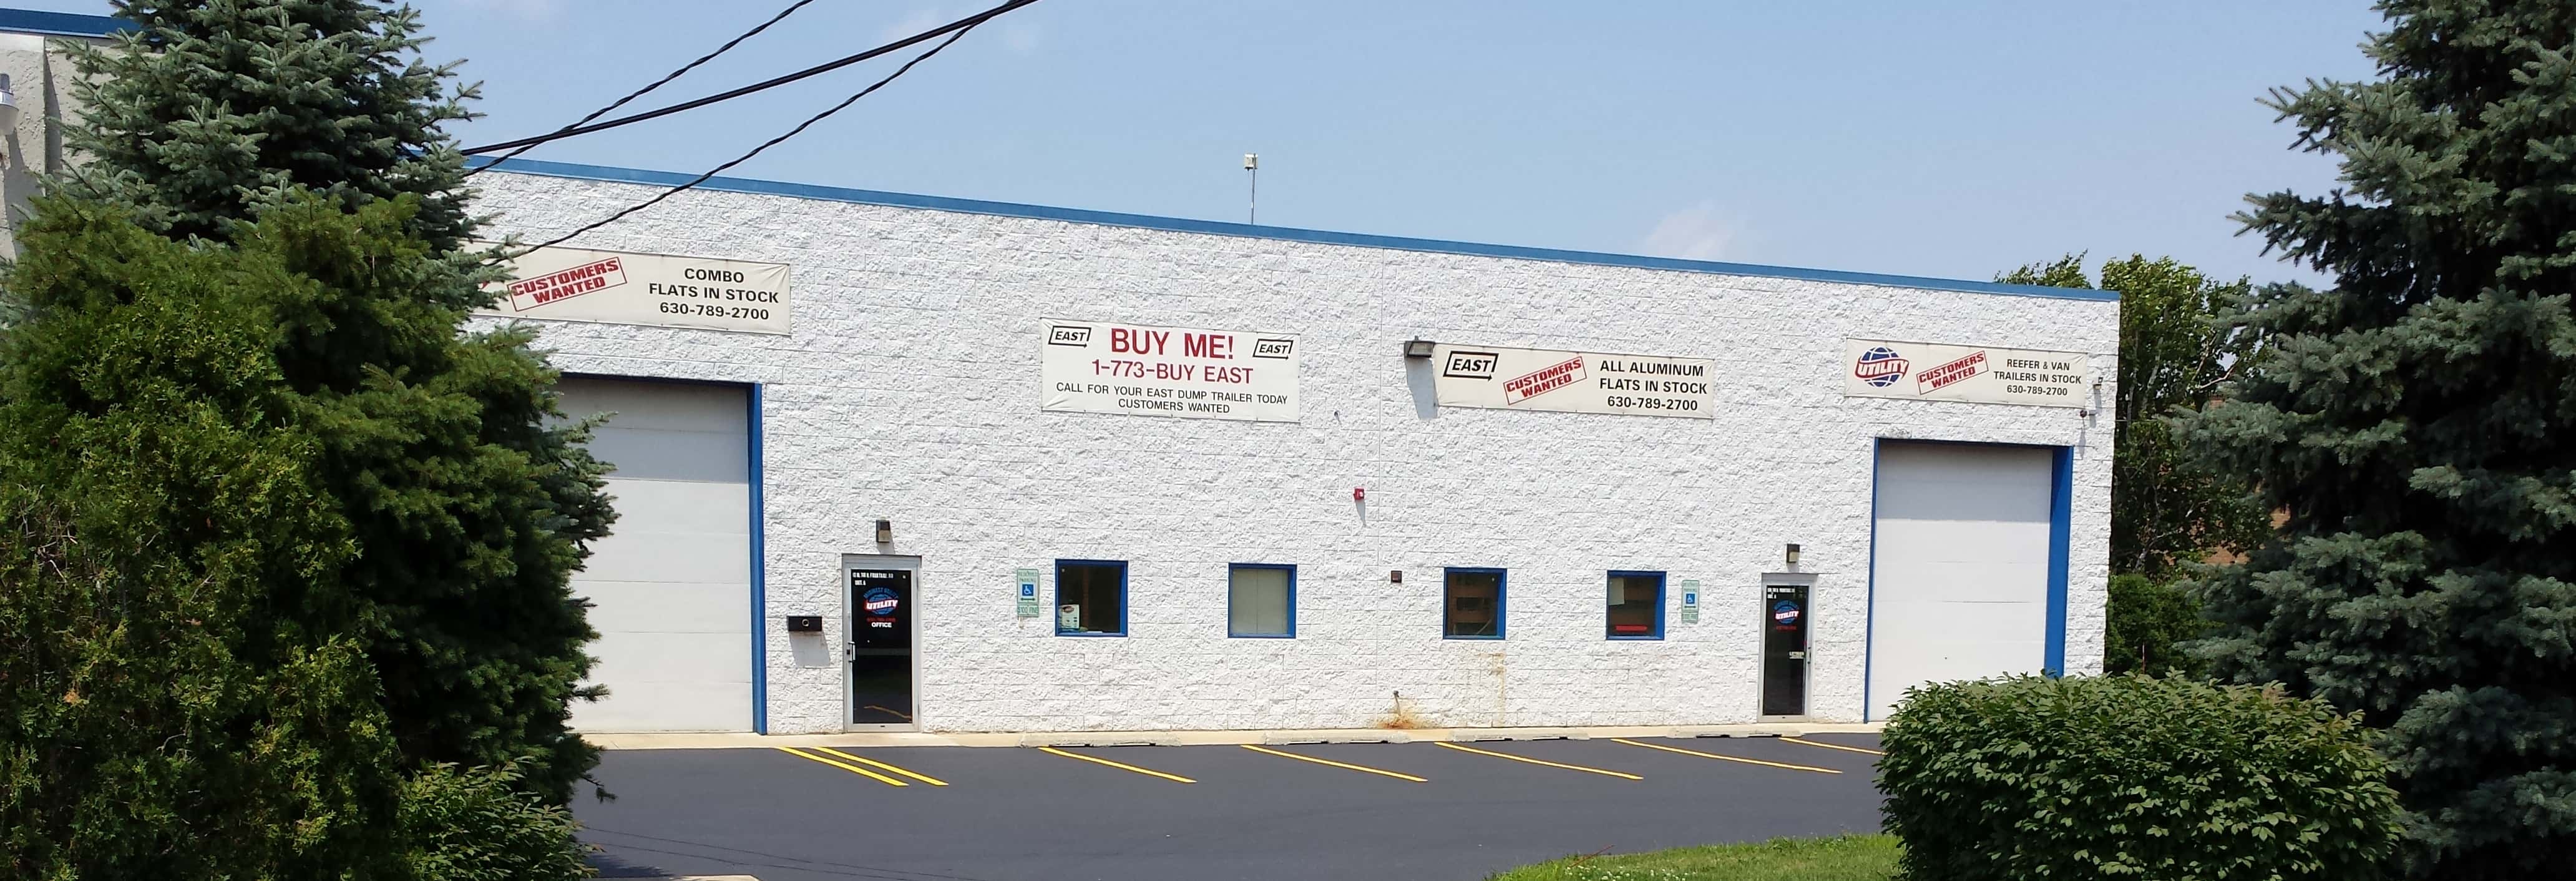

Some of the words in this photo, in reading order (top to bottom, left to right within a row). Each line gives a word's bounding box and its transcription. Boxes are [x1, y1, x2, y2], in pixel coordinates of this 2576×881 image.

[512, 259, 619, 297] CUSTOMERS
[684, 268, 744, 283] COMBO
[532, 276, 605, 304] WANTED
[649, 283, 698, 298] FLATS
[705, 287, 720, 300] IN
[726, 289, 779, 303] STOCK
[660, 302, 769, 320] 630-789-2700
[1055, 330, 1086, 342] EAST
[1111, 328, 1170, 355] BUY
[1184, 333, 1234, 360] ME!
[1258, 343, 1289, 355] EAST
[1091, 359, 1196, 381] 1-773-BUY
[1204, 366, 1253, 384] EAST
[1451, 358, 1491, 373] EAST
[1600, 360, 1625, 373] ALL
[1629, 362, 1704, 377] ALUMINUM
[1858, 360, 1909, 374] UTILITY
[1919, 353, 1984, 383] CUSTOMERS
[2007, 359, 2039, 370] REEFER
[2043, 361, 2048, 370] &
[2051, 362, 2070, 370] VAN
[1506, 360, 1582, 392] CUSTOMERS
[1931, 367, 1976, 388] WANTED
[1994, 371, 2036, 381] TRAILERS
[2039, 373, 2048, 382] IN
[2052, 374, 2081, 384] STOCK
[1056, 382, 1083, 393] CALL
[1087, 385, 1109, 394] FOR
[1114, 386, 1142, 397] YOUR
[1147, 388, 1173, 398] EAST
[1178, 390, 1207, 400] DUMP
[1211, 391, 1252, 403] TRAILER
[1256, 394, 1287, 405] TODAY
[1521, 373, 1572, 398] WANTED
[1599, 378, 1640, 391] FLATS
[1645, 380, 1658, 391] IN
[1663, 381, 1707, 395] STOCK
[2007, 385, 2067, 396] 630-789-2700
[1118, 398, 1184, 411] CUSTOMERS
[1188, 402, 1230, 413] WANTED
[1608, 396, 1698, 411] 630-789-2700
[867, 599, 898, 610] UTILITY
[1775, 611, 1798, 619] UTILITY
